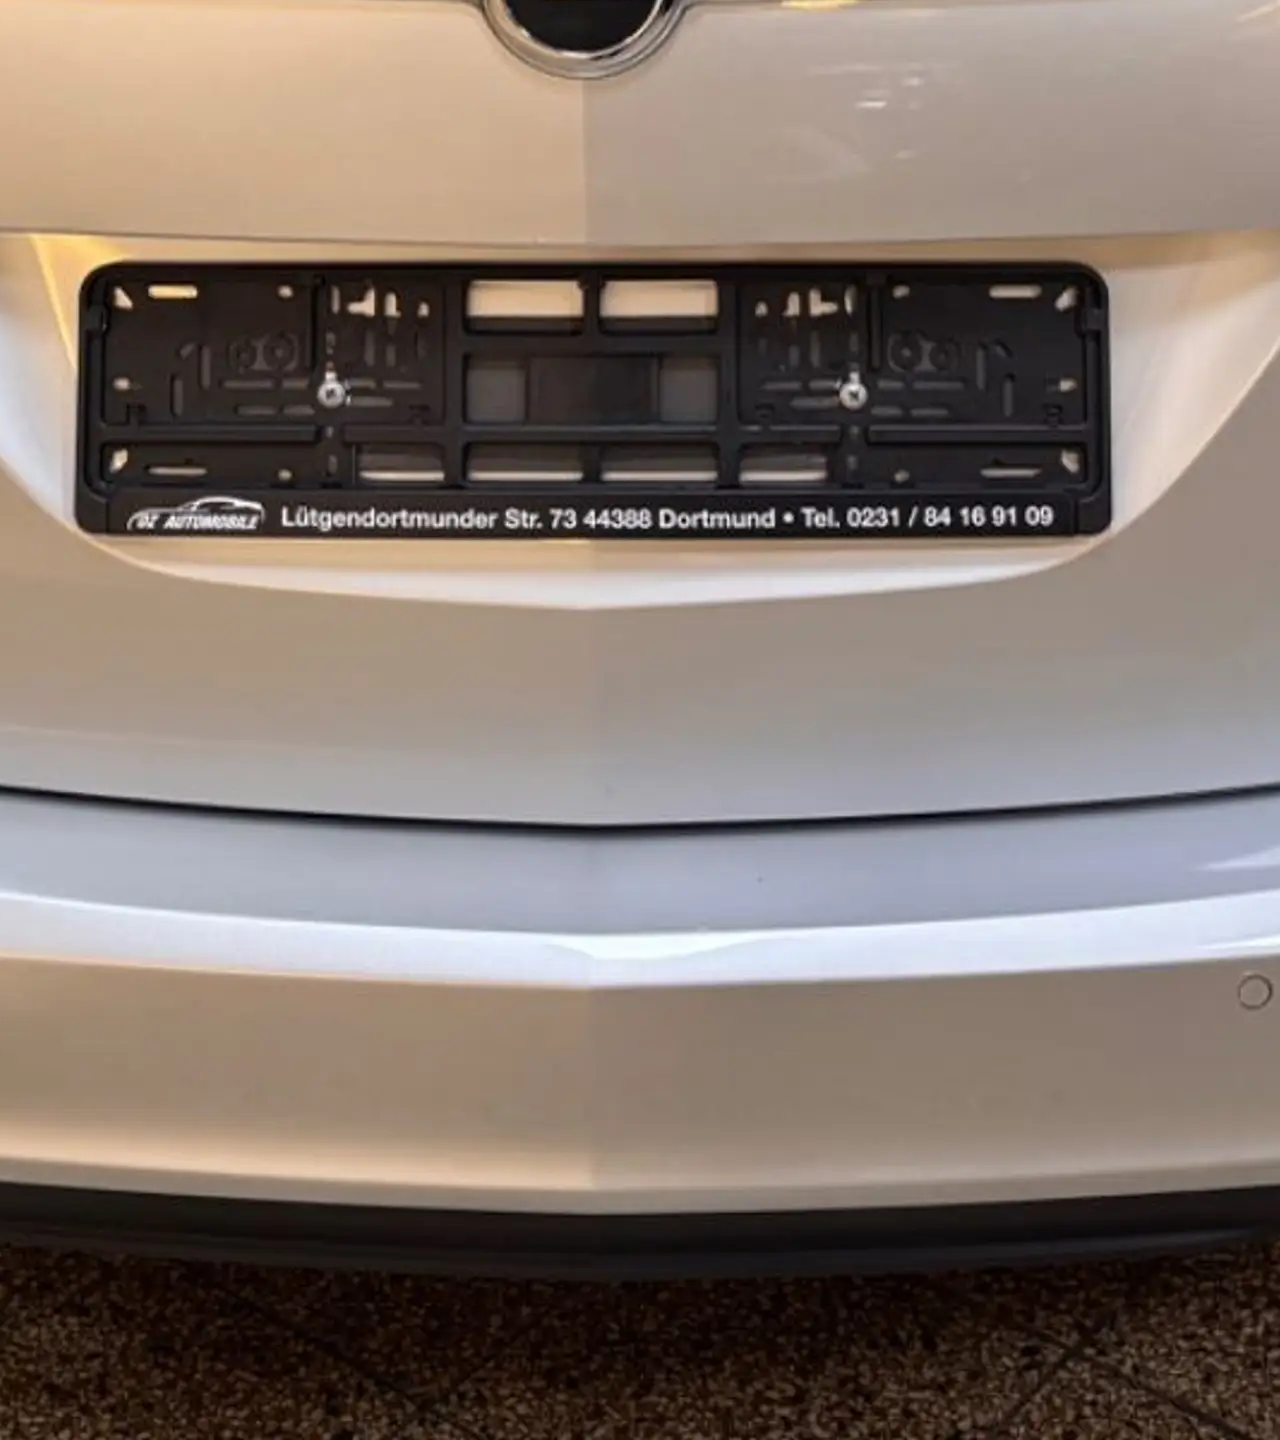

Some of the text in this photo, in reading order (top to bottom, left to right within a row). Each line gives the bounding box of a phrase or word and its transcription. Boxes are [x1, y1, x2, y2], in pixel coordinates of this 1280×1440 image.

[280, 506, 497, 531] Lütgendortmunder
[504, 508, 542, 529] Str.
[549, 508, 577, 529] 73
[583, 508, 652, 529] 44388
[658, 508, 776, 529] Dortmund
[802, 508, 840, 528] Tel.
[846, 507, 900, 528] 0231
[924, 506, 951, 527] 84
[959, 506, 987, 527] 16
[991, 506, 1017, 527] 91
[1024, 505, 1054, 527] 09
